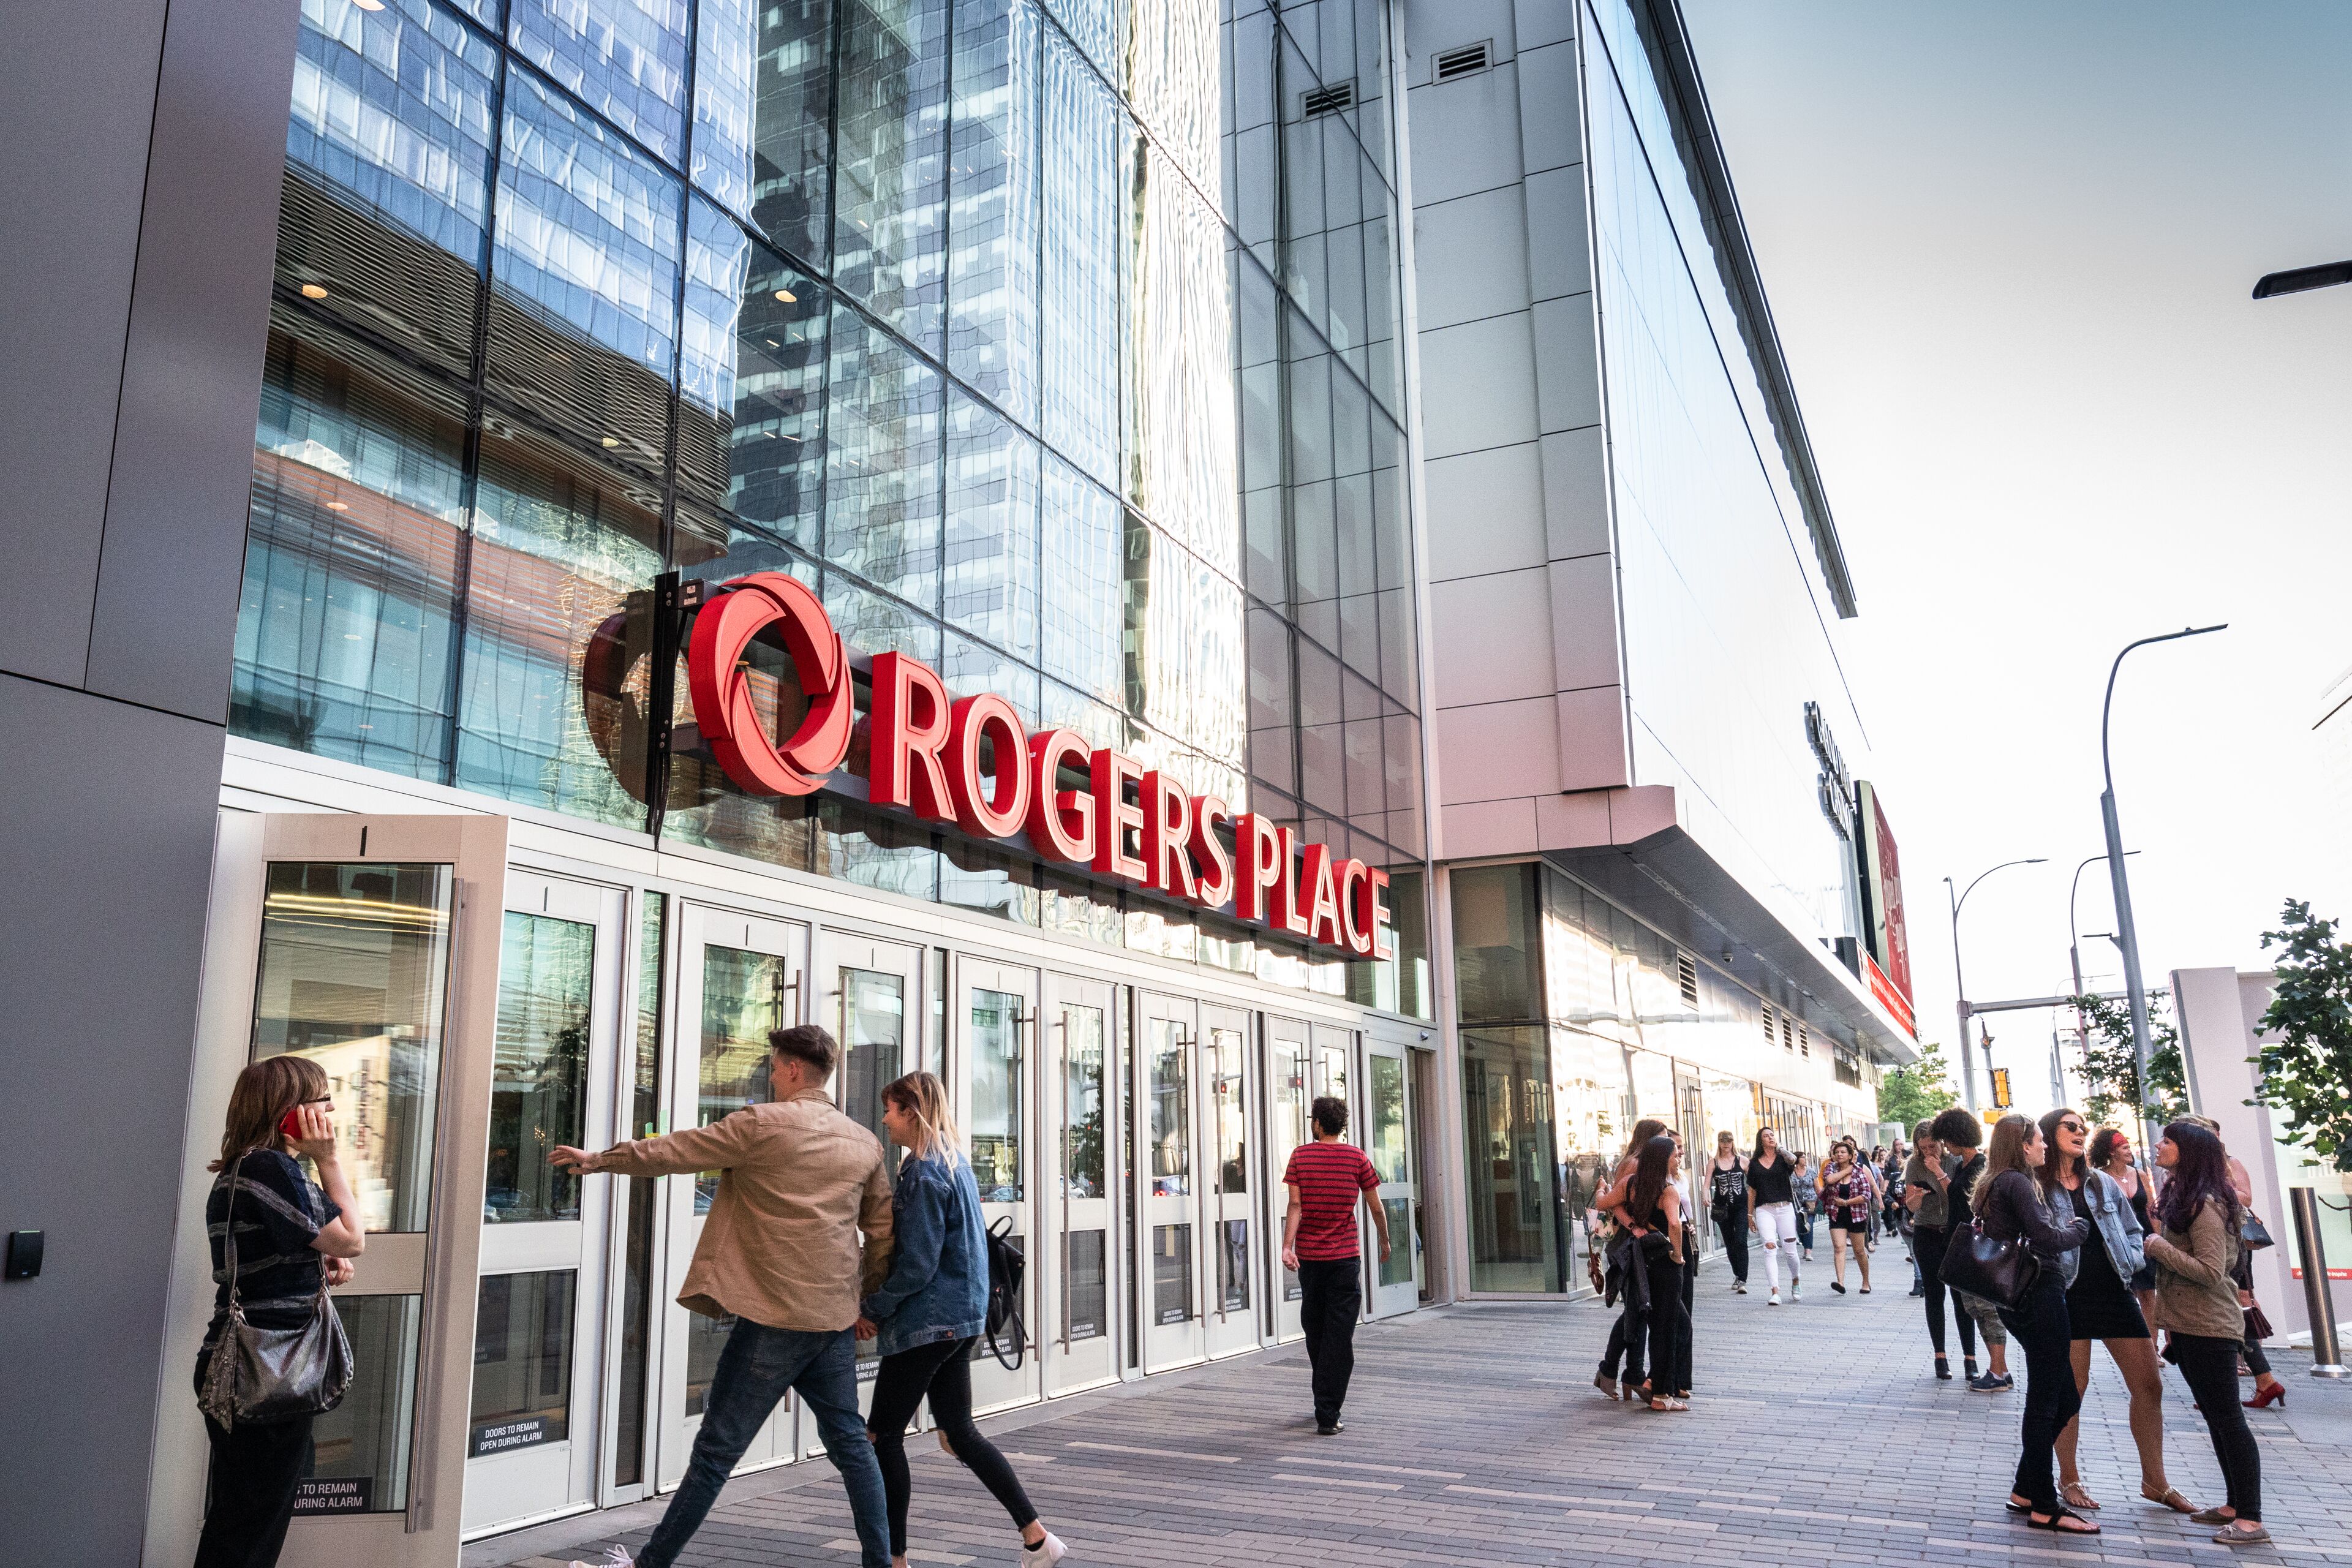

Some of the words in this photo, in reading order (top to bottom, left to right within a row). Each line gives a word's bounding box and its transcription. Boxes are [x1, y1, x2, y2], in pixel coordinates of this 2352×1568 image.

[870, 650, 1232, 907] ROGERS
[1235, 813, 1392, 961] PLACE
[865, 1360, 880, 1370] REMAIN
[869, 1369, 879, 1378] ALAR
[485, 1427, 506, 1439] DOORS
[507, 1425, 515, 1434] TO
[516, 1420, 539, 1433] REMAIN
[480, 1440, 497, 1451] OPEN
[498, 1436, 521, 1448] DURING
[521, 1431, 543, 1442] ALARM
[303, 1484, 315, 1494] TO
[318, 1482, 357, 1494] REMAIN
[294, 1498, 325, 1509] URING
[327, 1496, 363, 1508] ALARM
